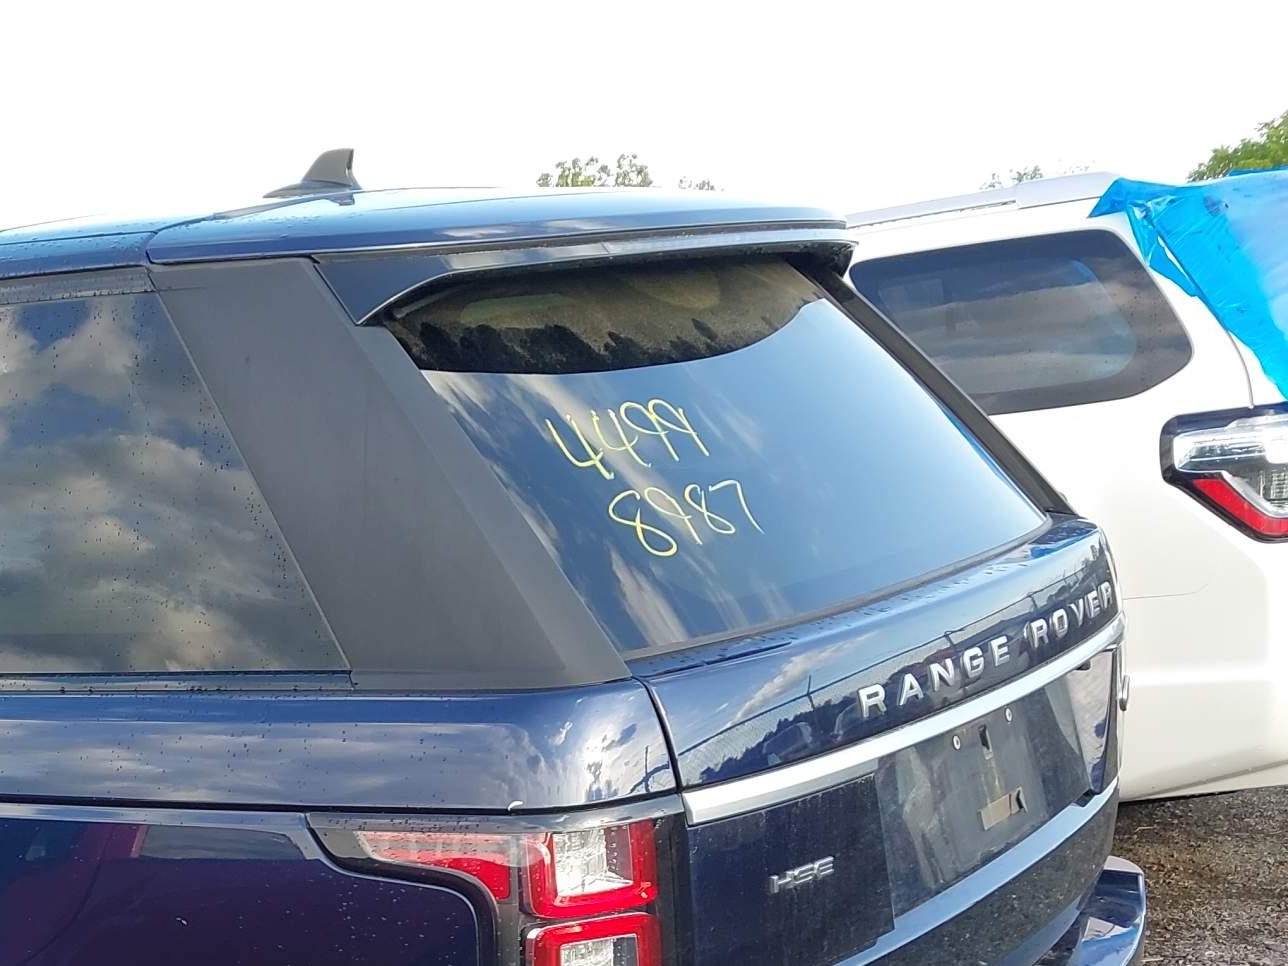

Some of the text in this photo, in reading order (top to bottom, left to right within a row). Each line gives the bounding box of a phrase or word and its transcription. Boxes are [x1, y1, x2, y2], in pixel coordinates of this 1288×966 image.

[545, 399, 710, 480] 4499
[608, 480, 766, 557] 8987
[857, 580, 1113, 718] RANGE ROVER
[769, 855, 835, 894] HSE
